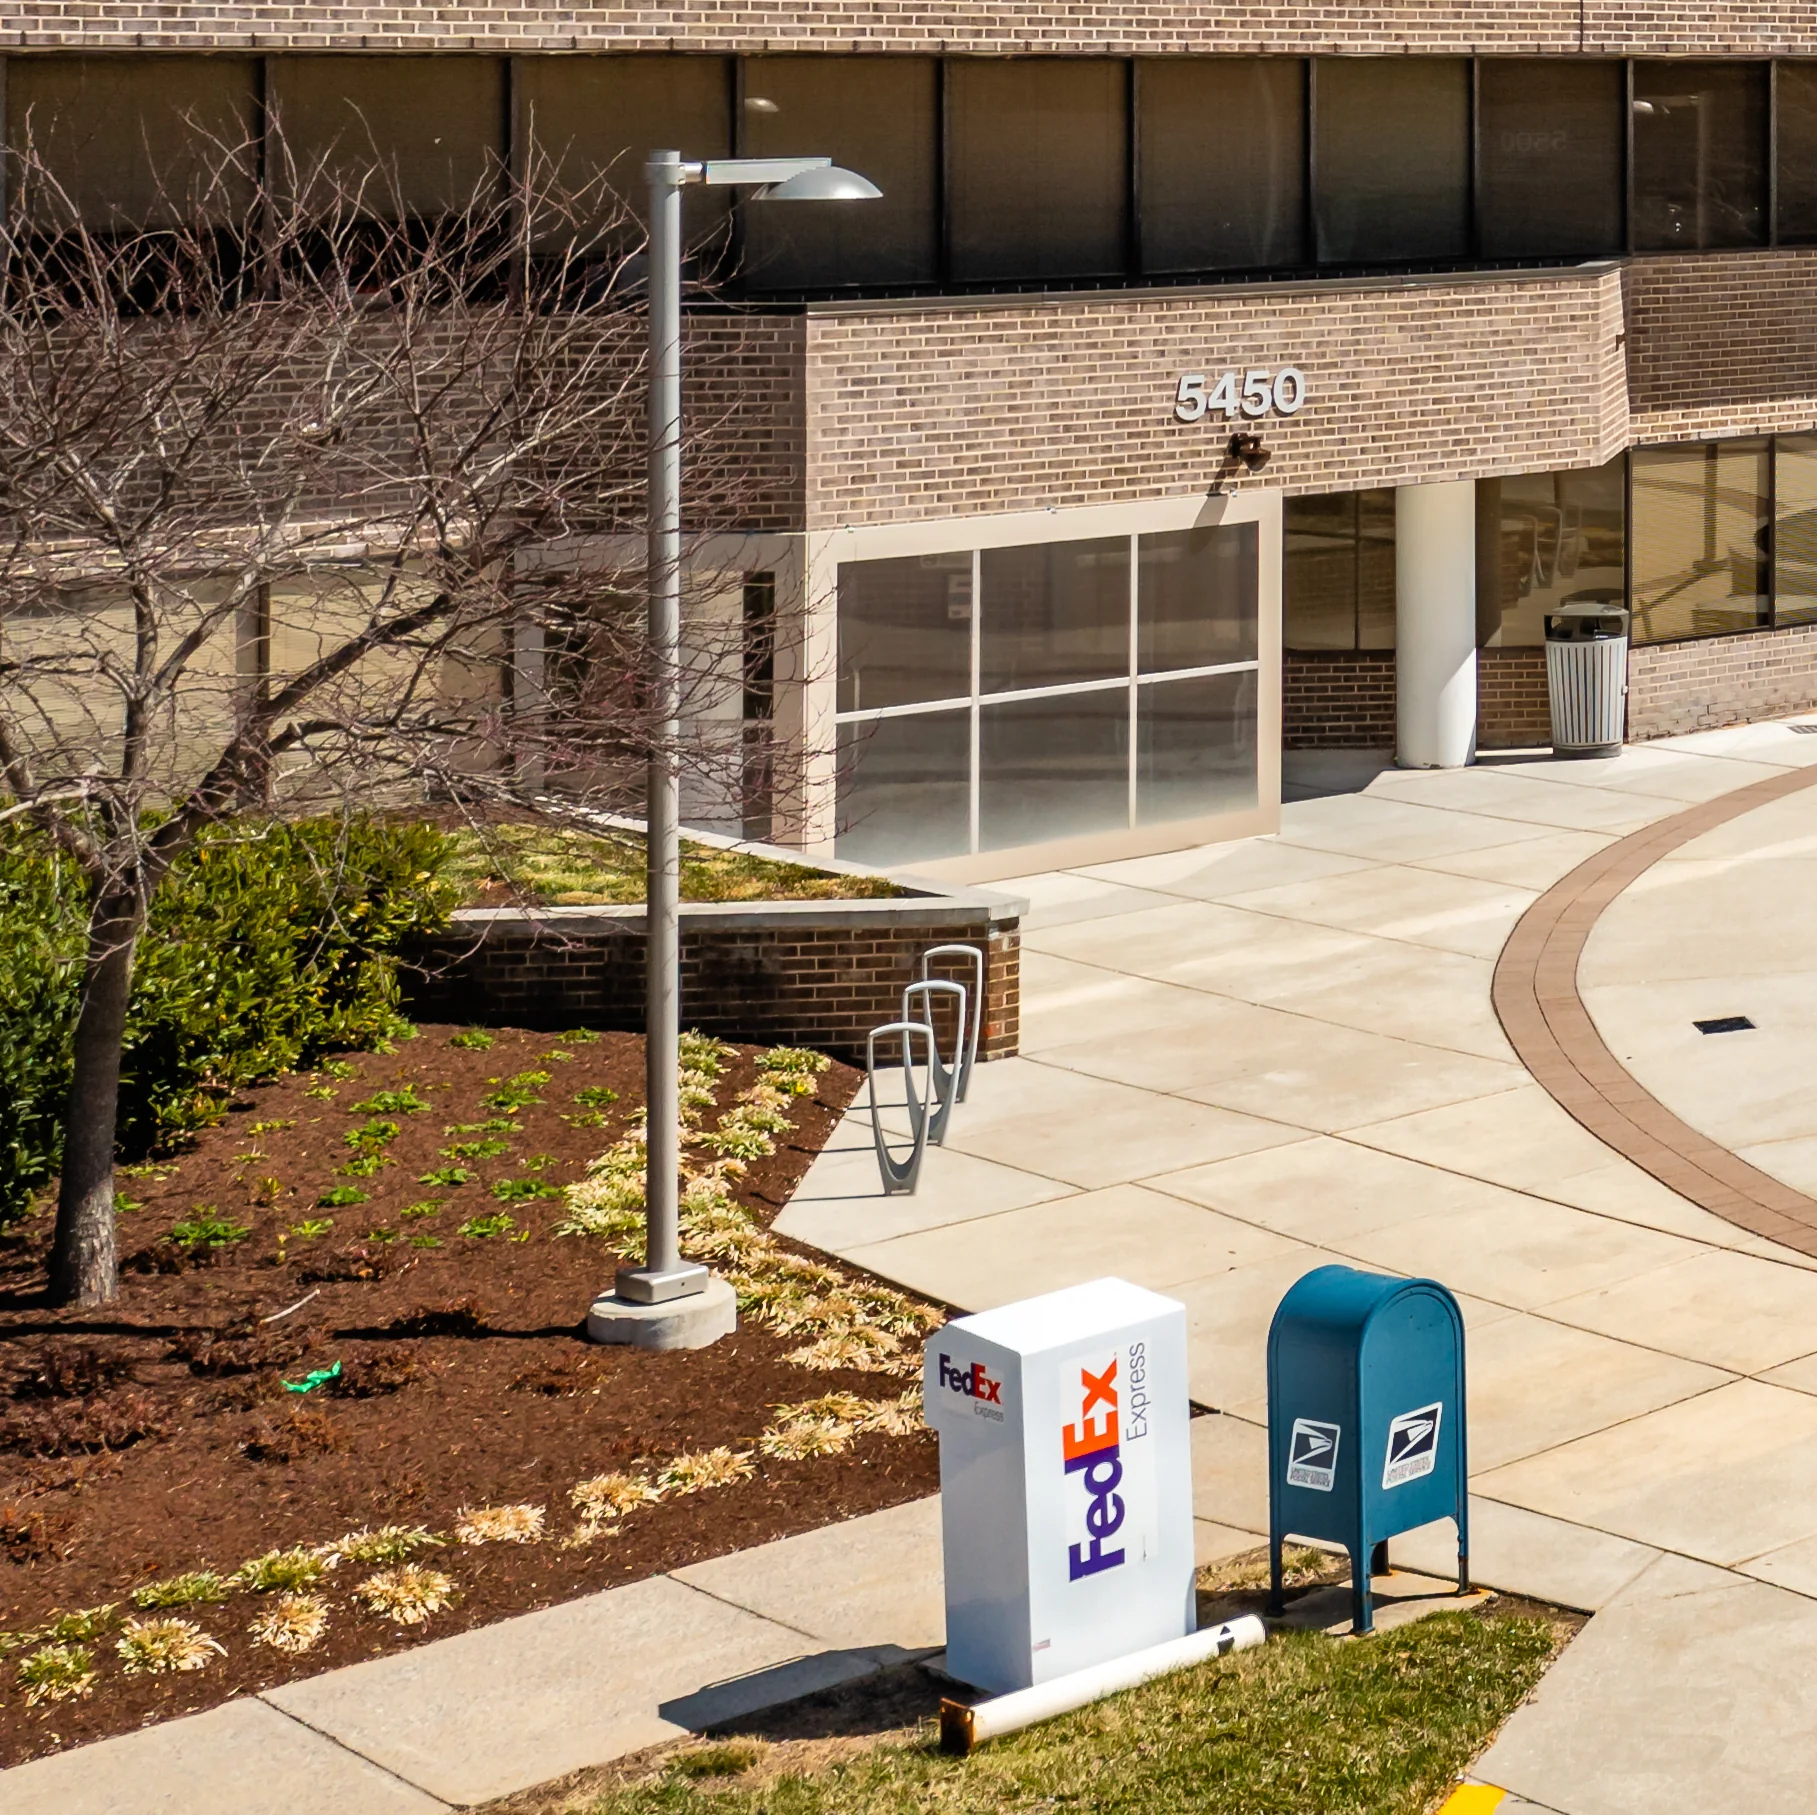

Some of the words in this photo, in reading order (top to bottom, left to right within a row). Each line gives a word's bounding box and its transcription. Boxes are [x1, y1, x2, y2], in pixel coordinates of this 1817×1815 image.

[1175, 367, 1306, 421] 5450
[938, 1352, 1002, 1406] FedEx
[1126, 1341, 1151, 1441] Express
[1062, 1357, 1125, 1582] FedEx
